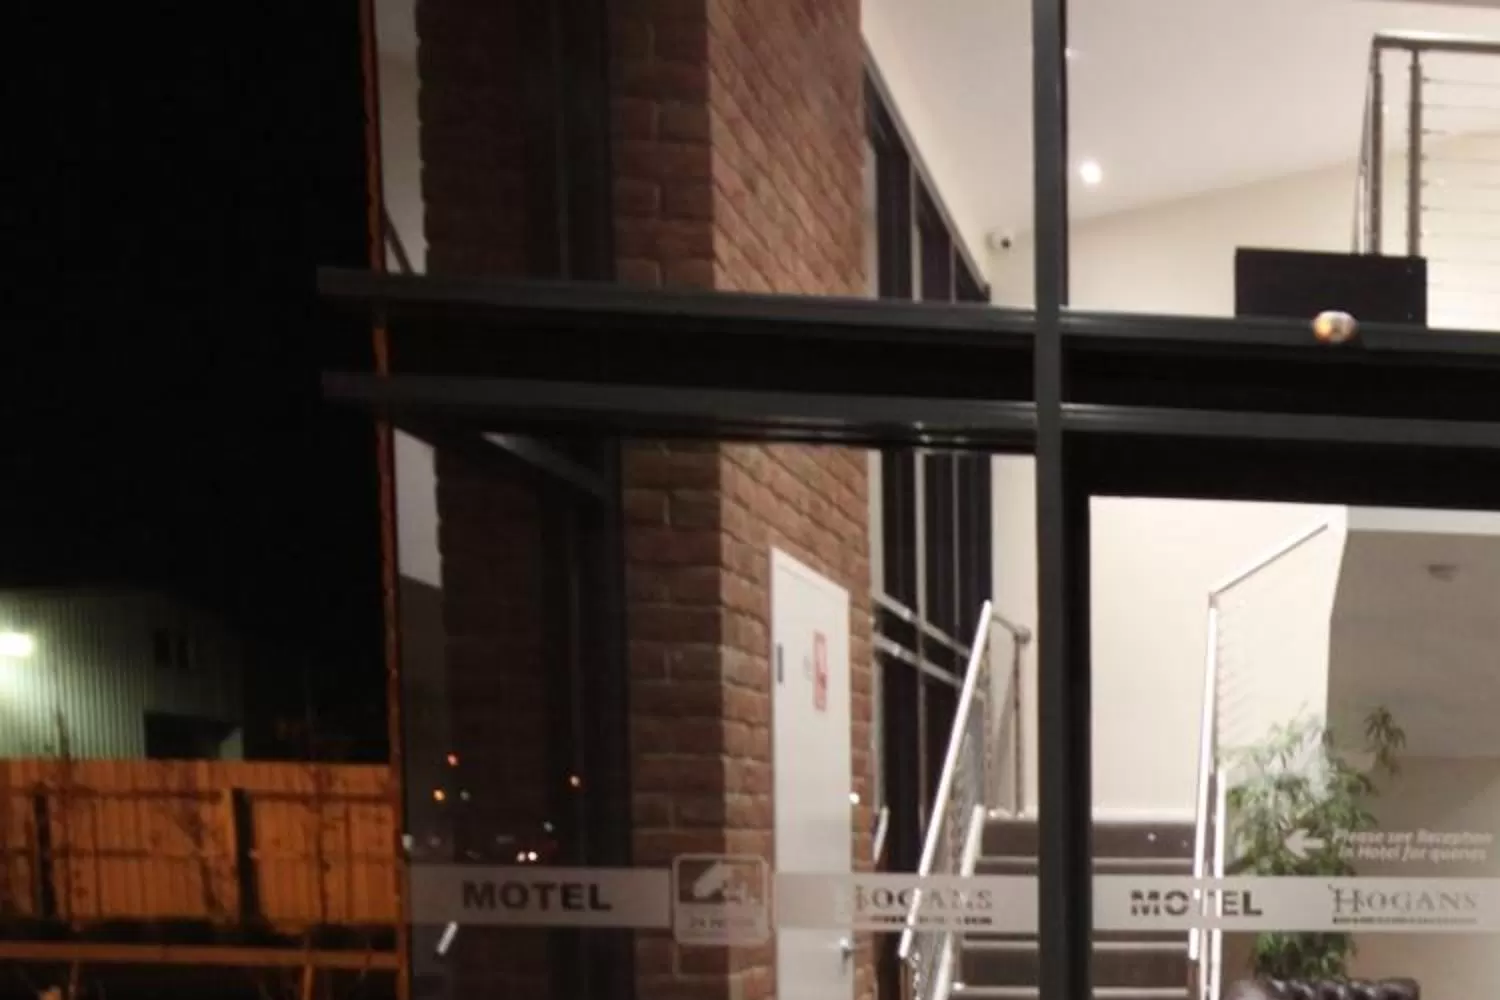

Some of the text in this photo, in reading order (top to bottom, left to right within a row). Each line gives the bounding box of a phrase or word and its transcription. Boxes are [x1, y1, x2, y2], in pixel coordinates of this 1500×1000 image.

[1359, 845, 1399, 860] Hotel
[462, 880, 613, 912] MOTEL
[837, 883, 993, 913] OGANS
[1130, 889, 1263, 917] MOEL
[1328, 884, 1477, 913] HOGANS
